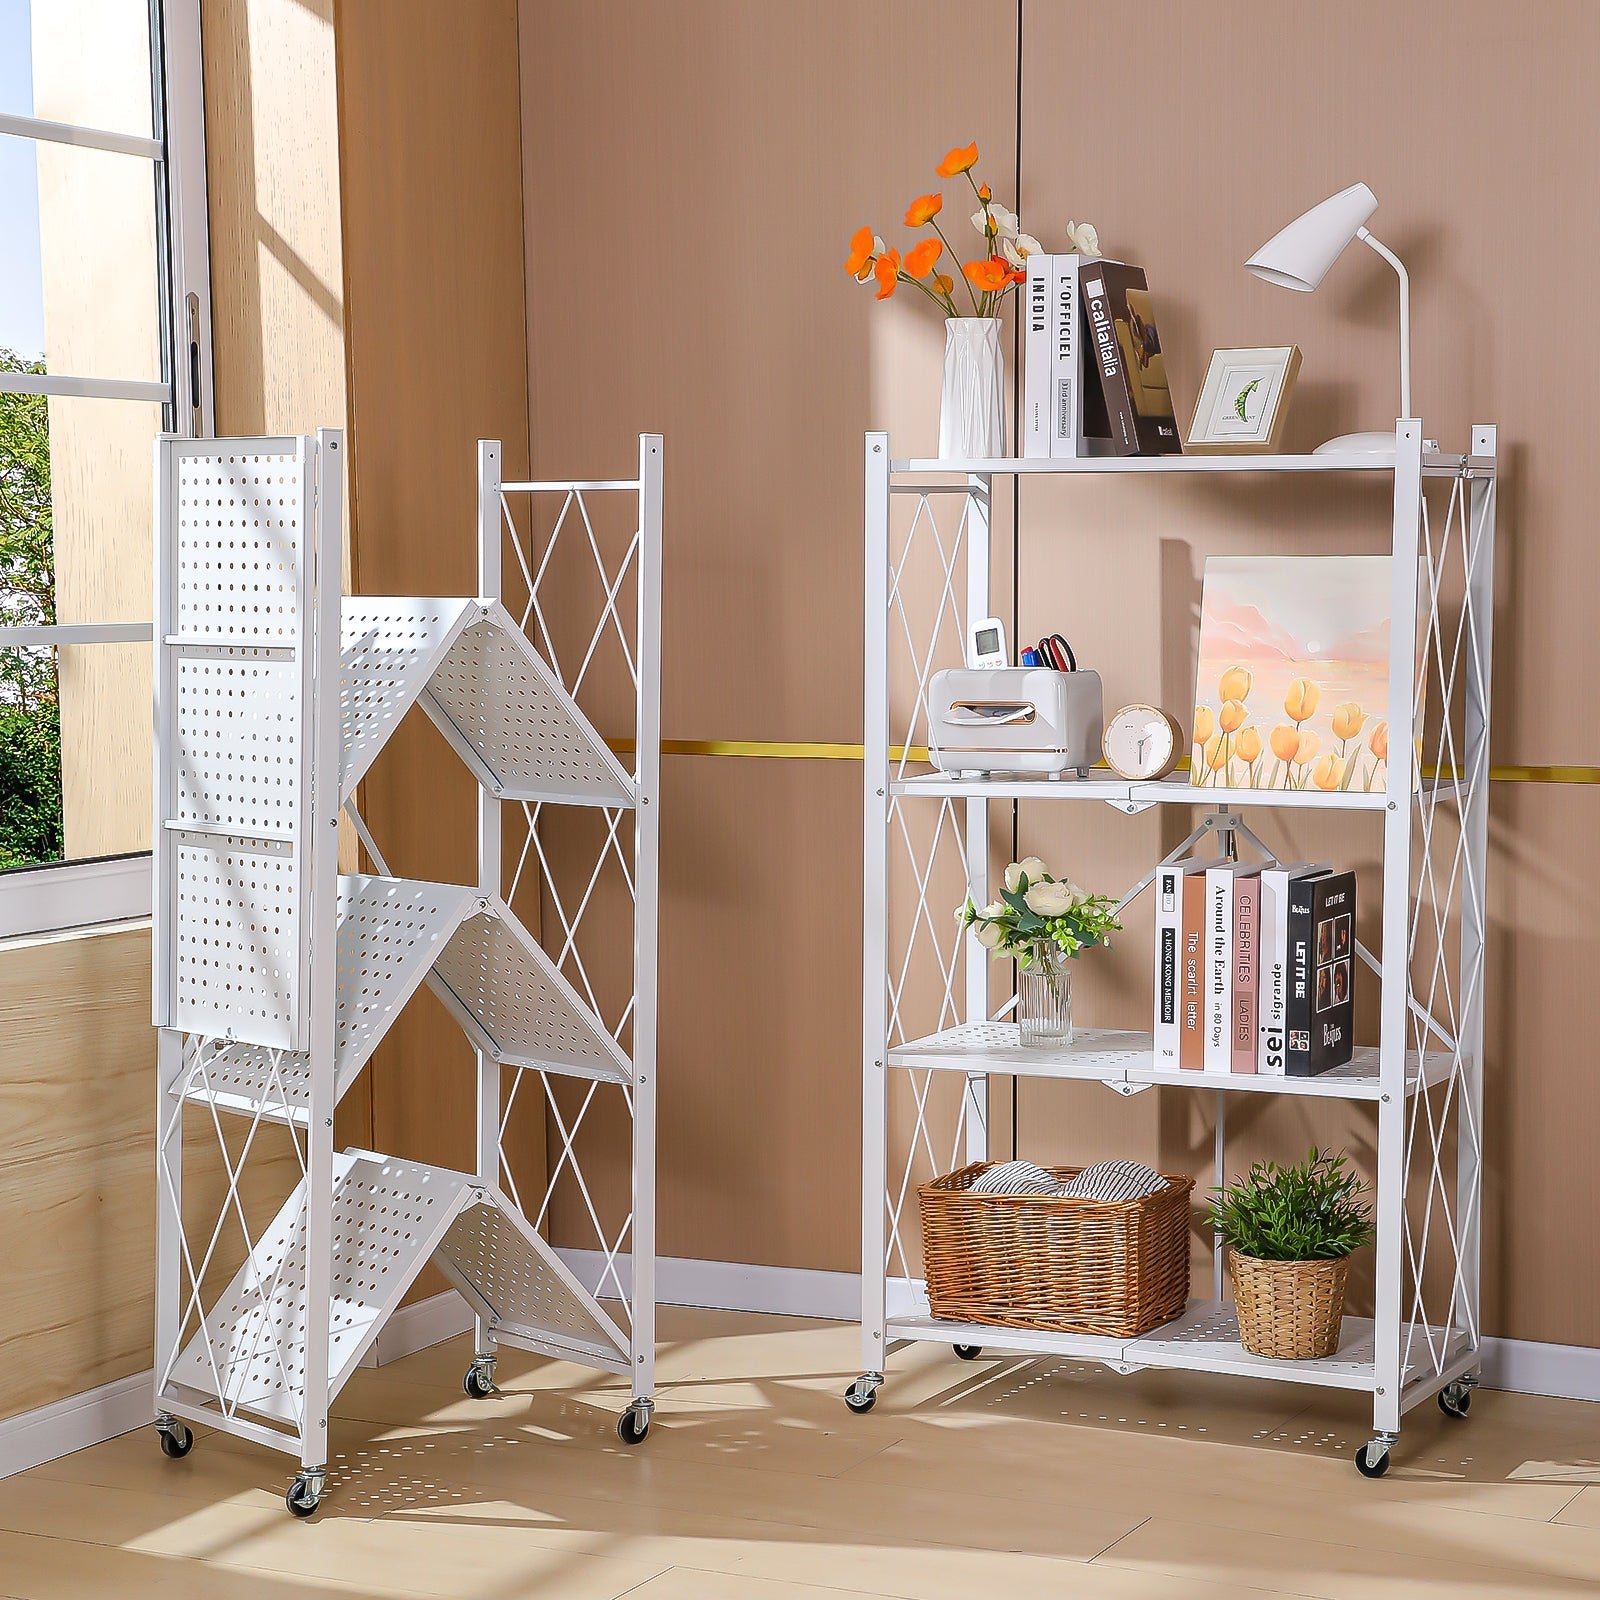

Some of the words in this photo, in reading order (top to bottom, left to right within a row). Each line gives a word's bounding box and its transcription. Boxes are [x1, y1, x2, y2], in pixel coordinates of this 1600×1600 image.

[1033, 277, 1045, 332] INEDIA
[1059, 276, 1071, 360] L'OFFICIEL
[1091, 299, 1118, 377] caliaitalia
[1060, 398, 1068, 436] anniversary
[1215, 885, 1226, 933] Around
[1188, 931, 1199, 953] The
[1215, 937, 1225, 956] the
[1238, 895, 1251, 983] CELEBRITIES
[1295, 941, 1306, 965] LET
[1214, 959, 1225, 995] Earth
[1295, 967, 1305, 979] IT
[1295, 981, 1305, 999] BE
[1164, 988, 1172, 1021] MEMOIR
[1214, 1002, 1222, 1011] in
[1270, 963, 1284, 1020] sigrande
[1187, 1001, 1198, 1031] letter
[1214, 1013, 1222, 1025] 80
[1239, 999, 1249, 1041] LADIES
[1212, 1027, 1222, 1047] Days
[1261, 1026, 1283, 1068] sei
